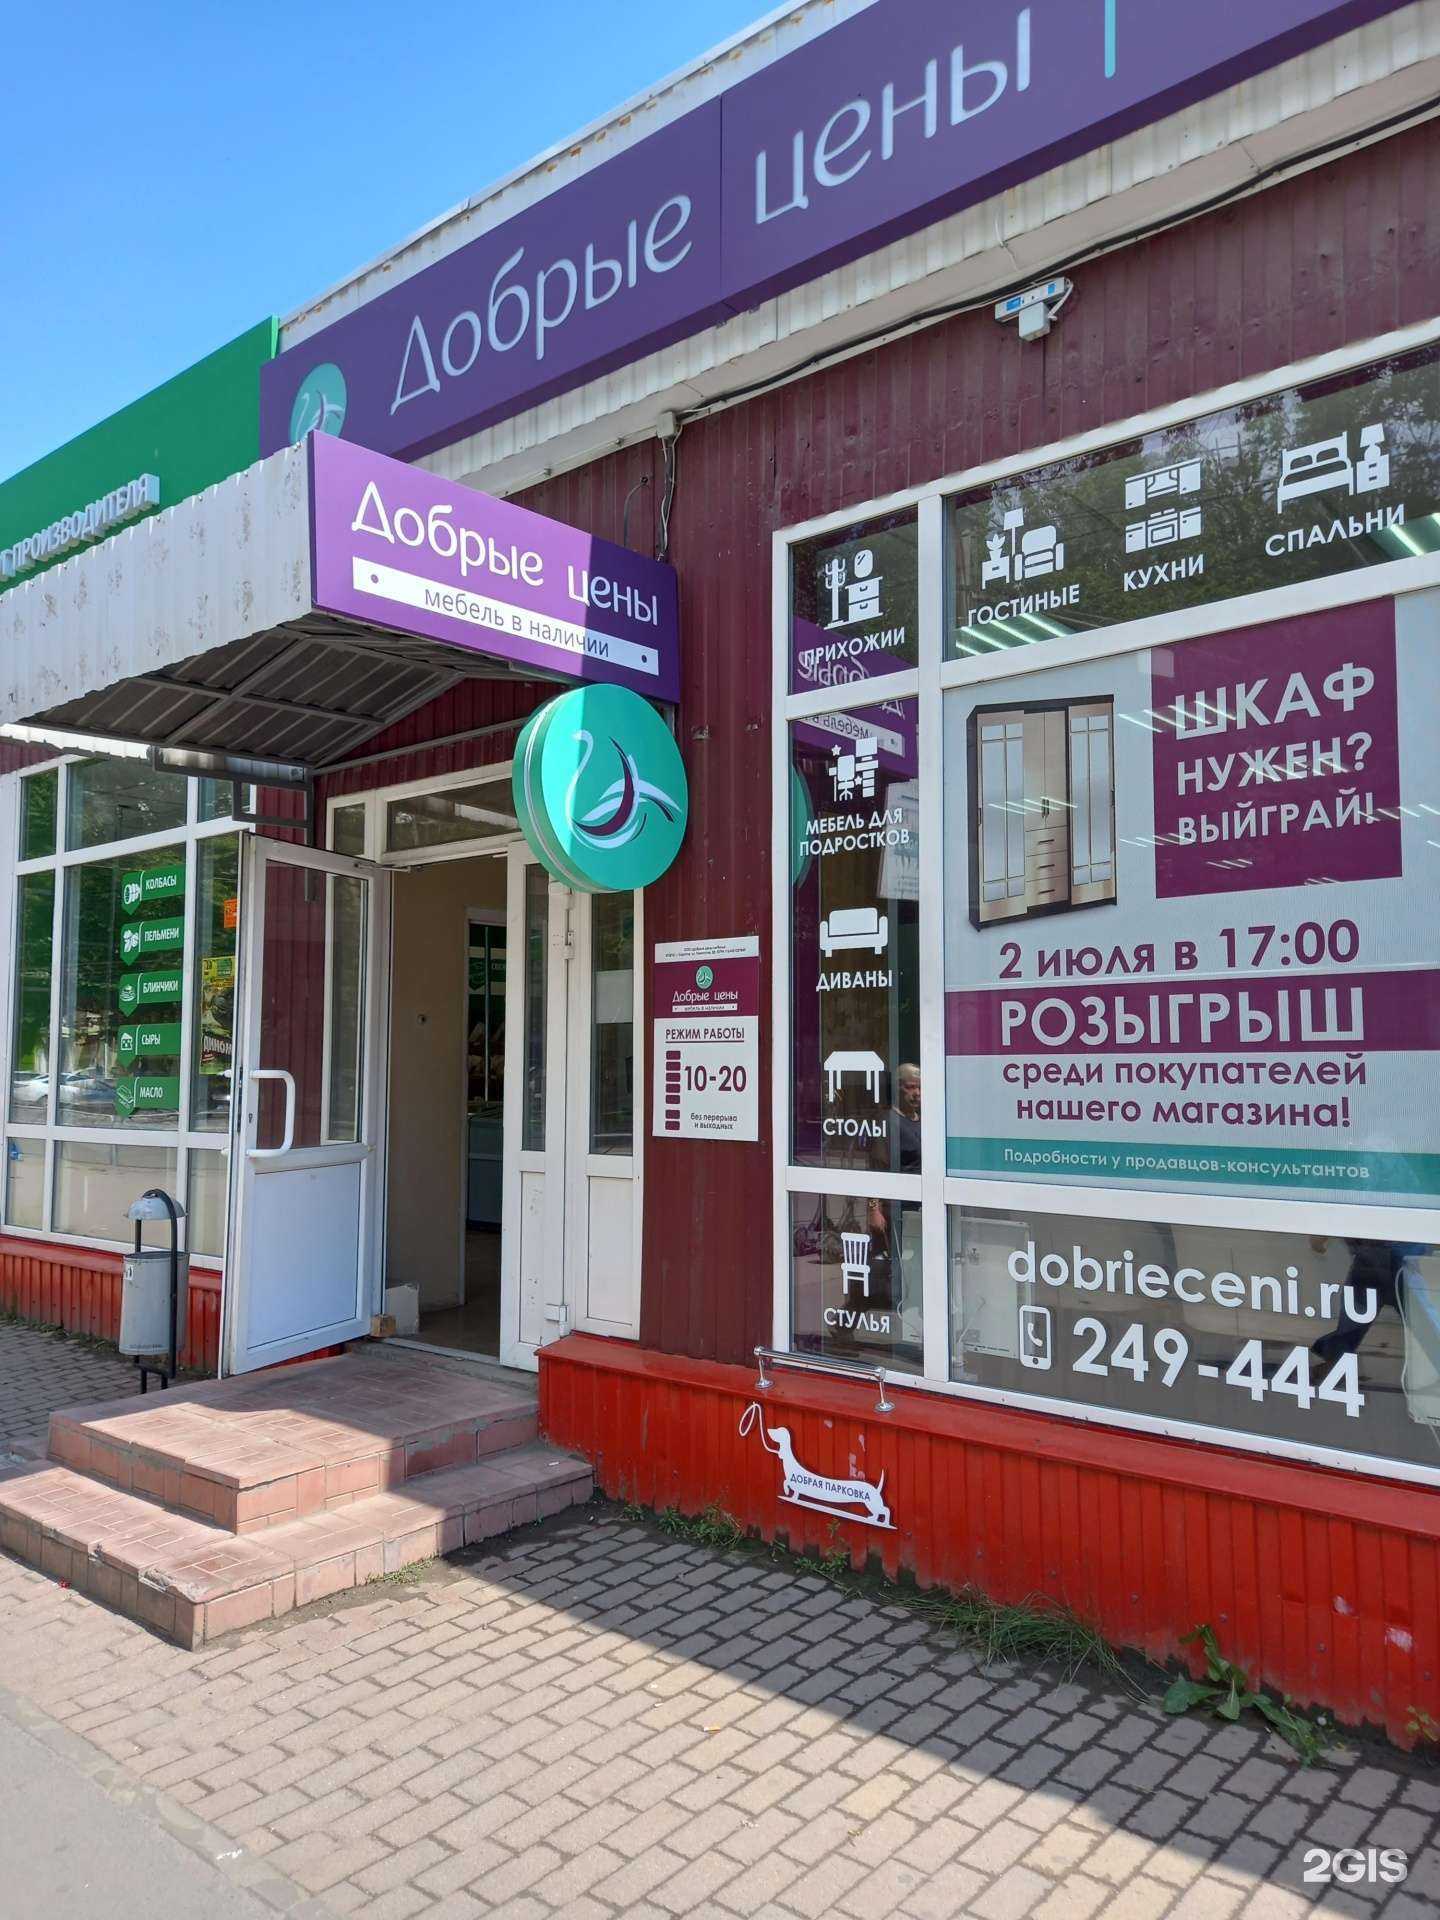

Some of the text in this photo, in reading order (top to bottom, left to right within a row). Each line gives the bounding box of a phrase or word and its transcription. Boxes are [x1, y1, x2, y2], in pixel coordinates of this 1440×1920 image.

[391, 9, 1031, 416] Добрые цены
[13, 473, 159, 576] ПРОИЗВОДИТЕЛЯ
[1265, 504, 1405, 557] СПАЛЬНИ
[351, 480, 658, 626] Добрые цены
[1123, 554, 1205, 592] КУХНИ
[967, 584, 1081, 629] ГОСТИНЫЕ
[424, 588, 610, 658] мебель в наличии
[1174, 662, 1376, 741] ШКАФ
[1177, 732, 1373, 796] НУЖЕН?
[805, 807, 903, 836] МЕБЕЛЬ ДЛЯ
[1178, 787, 1377, 846] ВЫЙГРАЙ!
[799, 829, 910, 857] ПОДРОСТКОВ
[145, 875, 177, 890] КОЛБАСЫ
[144, 927, 179, 942] ПЕЛЬМЕНИ
[999, 942, 1022, 979] 2
[1219, 919, 1360, 968] 17:00
[142, 980, 179, 994] БЛИНЧИКИ
[672, 989, 738, 1004] Добрые цены
[815, 969, 893, 993] ДИВАНЫ
[1001, 987, 1365, 1047] РОЗЫГРЫШ
[141, 1034, 161, 1045] СЫРЫ
[665, 1028, 745, 1040] РЕЖИМ РАБОТЫ
[684, 1065, 747, 1093] 10-20
[1002, 1053, 1367, 1090] среди покупателей
[139, 1087, 163, 1099] МАСЛО
[690, 1112, 738, 1123] без перерыва
[700, 1122, 733, 1130] выходных
[822, 1117, 887, 1139] СТОЛЫ
[1016, 1096, 1351, 1128] нашего магазина!
[1004, 1148, 1370, 1180] Подробности у продавцов-консультантов
[1007, 1241, 1378, 1324] dobrieceni.ru
[823, 1307, 891, 1335] СТУЛЬЯ
[1072, 1318, 1366, 1418] 249-444
[790, 1473, 870, 1501] ДОБРАЯ ПАРКОВКА
